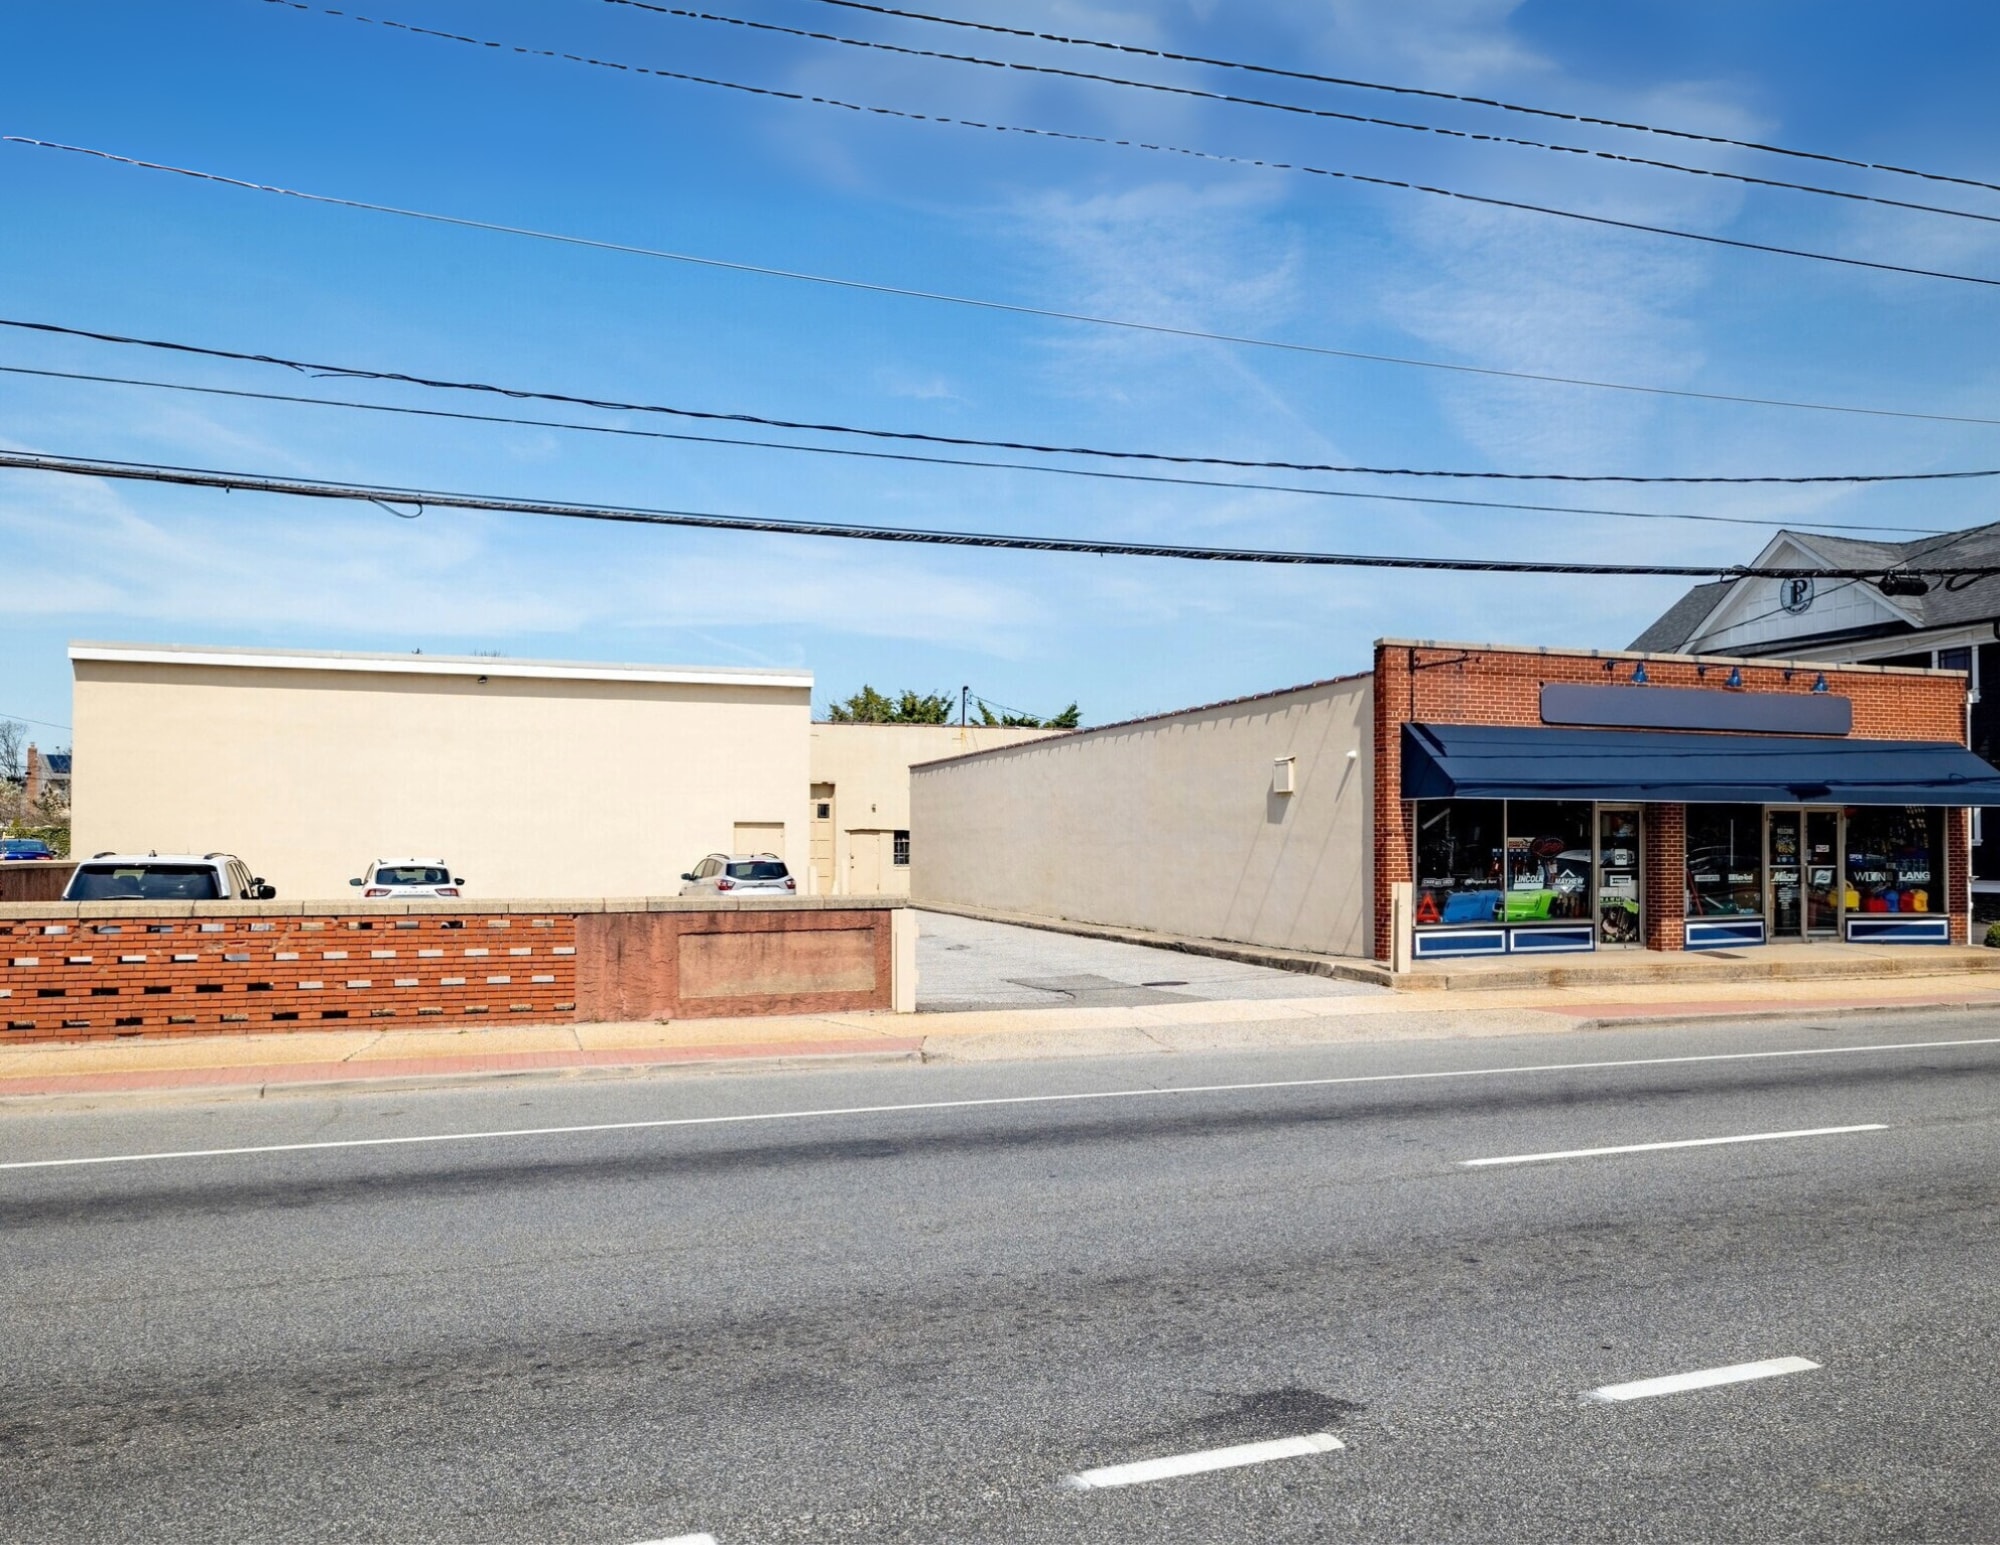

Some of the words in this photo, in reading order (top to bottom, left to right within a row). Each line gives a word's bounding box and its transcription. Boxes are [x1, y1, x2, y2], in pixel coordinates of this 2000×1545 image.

[1514, 874, 1545, 883] LINCOLN
[1899, 871, 1931, 880] LANG
[1554, 877, 1585, 885] MAYHEW
